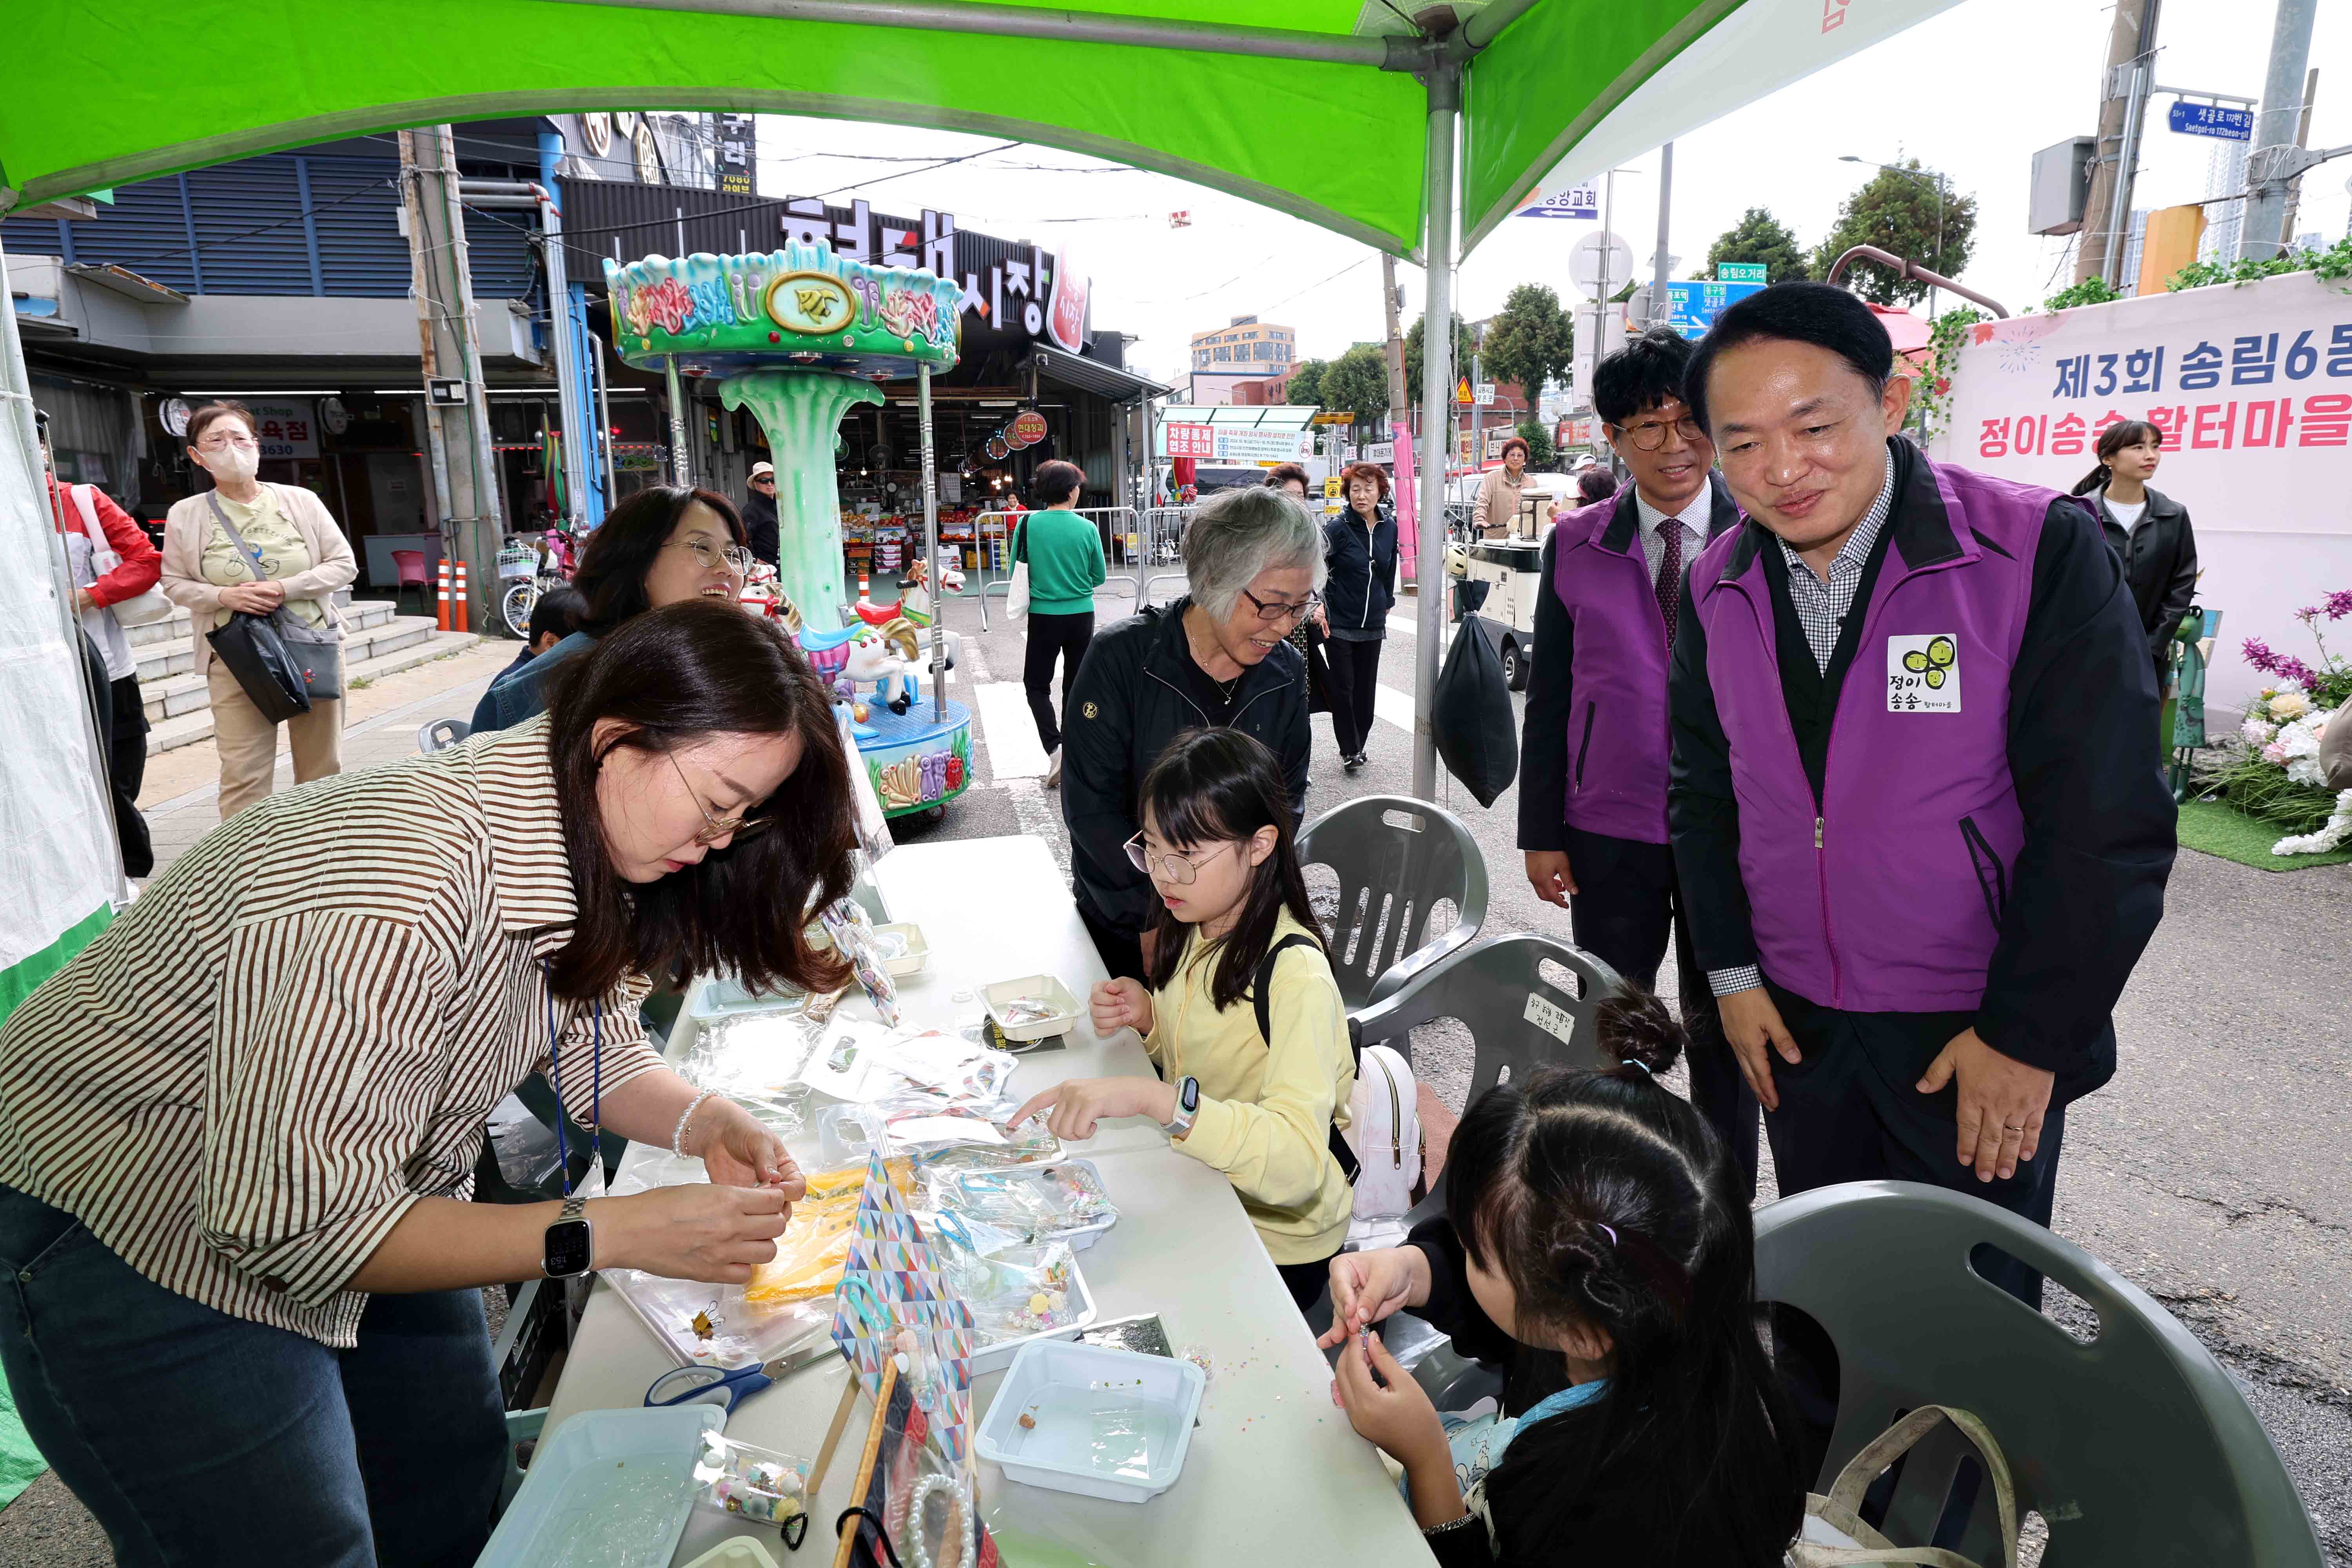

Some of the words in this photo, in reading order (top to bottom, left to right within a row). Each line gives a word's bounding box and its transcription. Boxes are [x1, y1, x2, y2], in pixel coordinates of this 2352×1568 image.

[2198, 108, 2225, 123] 샛골로
[2226, 113, 2252, 128] 172번길
[2185, 123, 2215, 134] Saetgol-ro
[2216, 127, 2249, 139] 172beon-gil
[722, 184, 750, 194] 라이브
[1720, 267, 1764, 279] 송림오거리
[1706, 287, 1725, 295] 동구청
[1704, 297, 1726, 308] 샛골로
[1060, 295, 1080, 334] 시장
[2053, 346, 2165, 399] 제3회
[2179, 323, 2352, 390] 송림6동
[263, 407, 293, 417] Shop
[261, 420, 309, 441] 육점
[1018, 423, 1043, 433] 현대청과
[1169, 426, 1211, 441] 차량통제
[1169, 440, 1189, 452] 협조
[1192, 441, 1210, 454] 안내
[1889, 675, 1920, 690] 정이
[1891, 692, 1922, 710] 송송
[550, 1255, 568, 1265] 1:53
